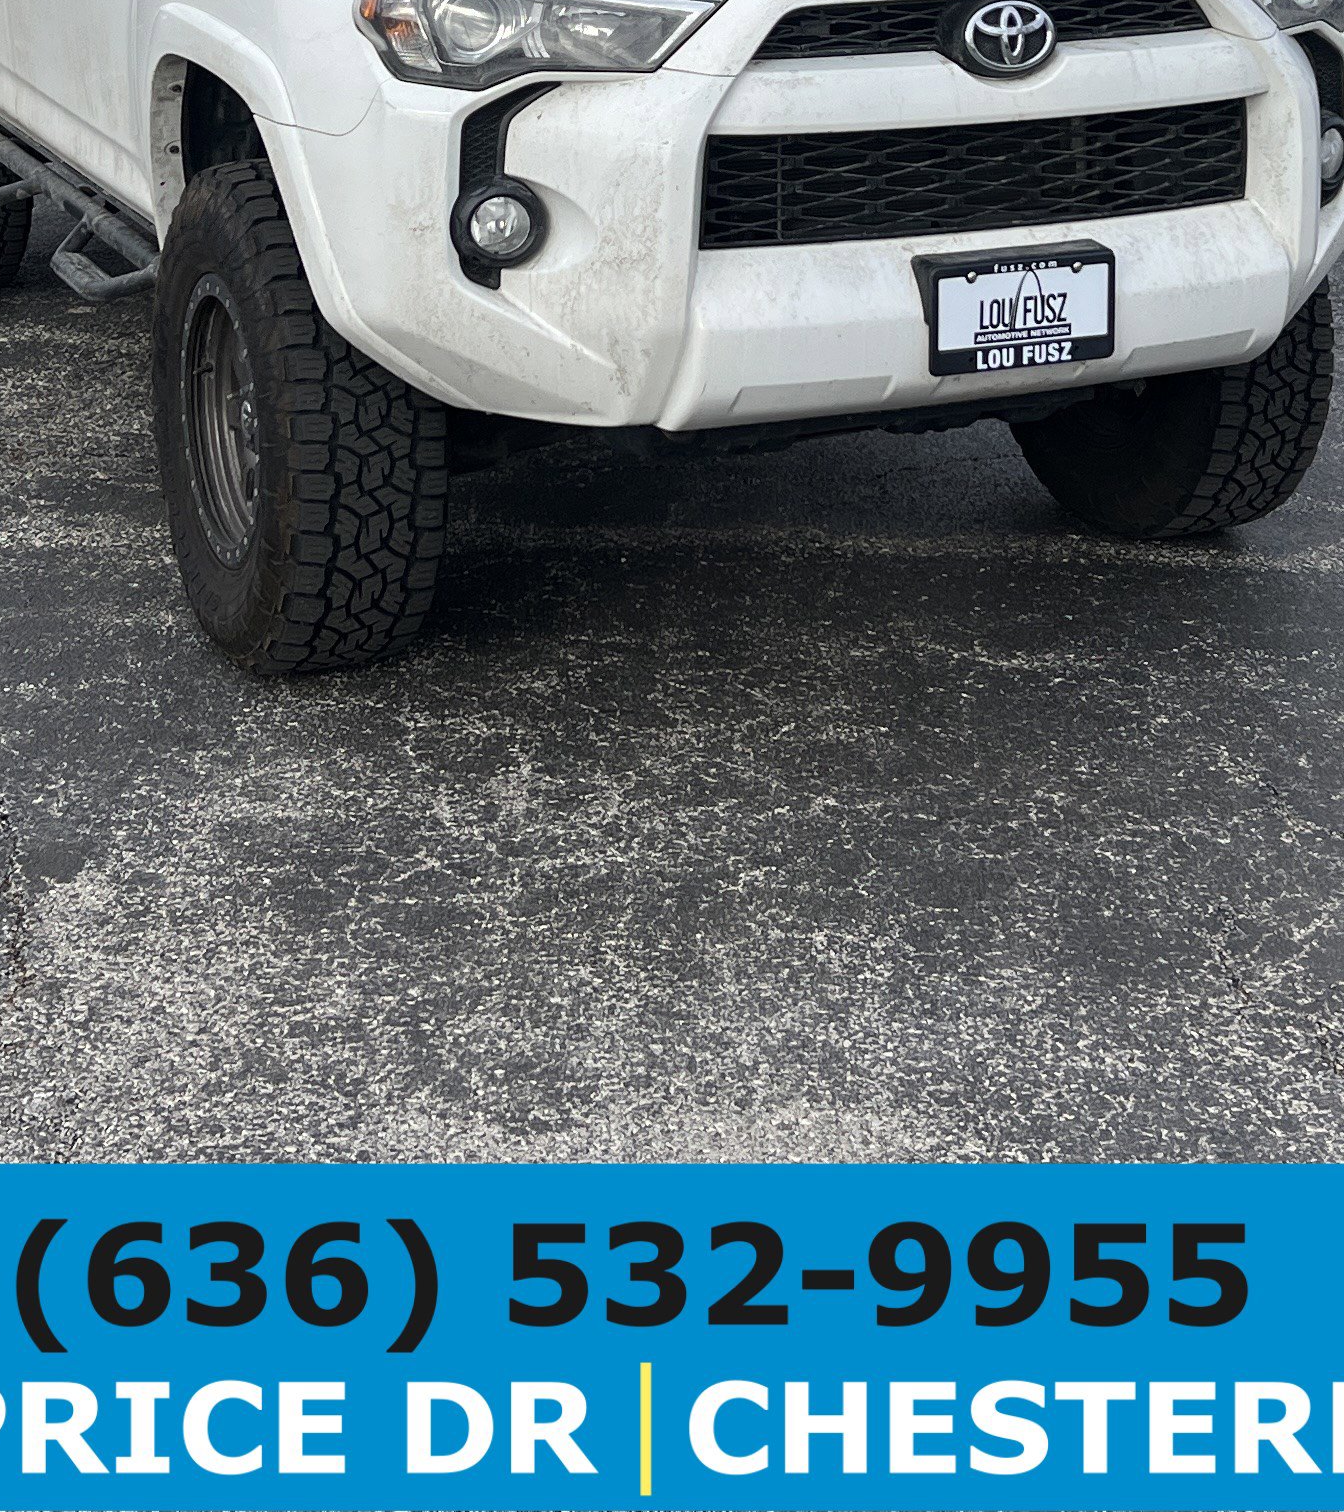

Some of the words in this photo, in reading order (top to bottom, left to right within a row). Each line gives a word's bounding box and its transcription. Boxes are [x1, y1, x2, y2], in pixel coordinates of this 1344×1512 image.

[993, 260, 1058, 273] fusz.com
[979, 298, 1014, 330] LOU
[1023, 292, 1068, 326] FUSZ
[976, 330, 1028, 342] AUTOMOTIVE
[1030, 326, 1071, 338] NETWORK
[976, 348, 1015, 371] LOU
[1022, 341, 1072, 365] FUSZ
